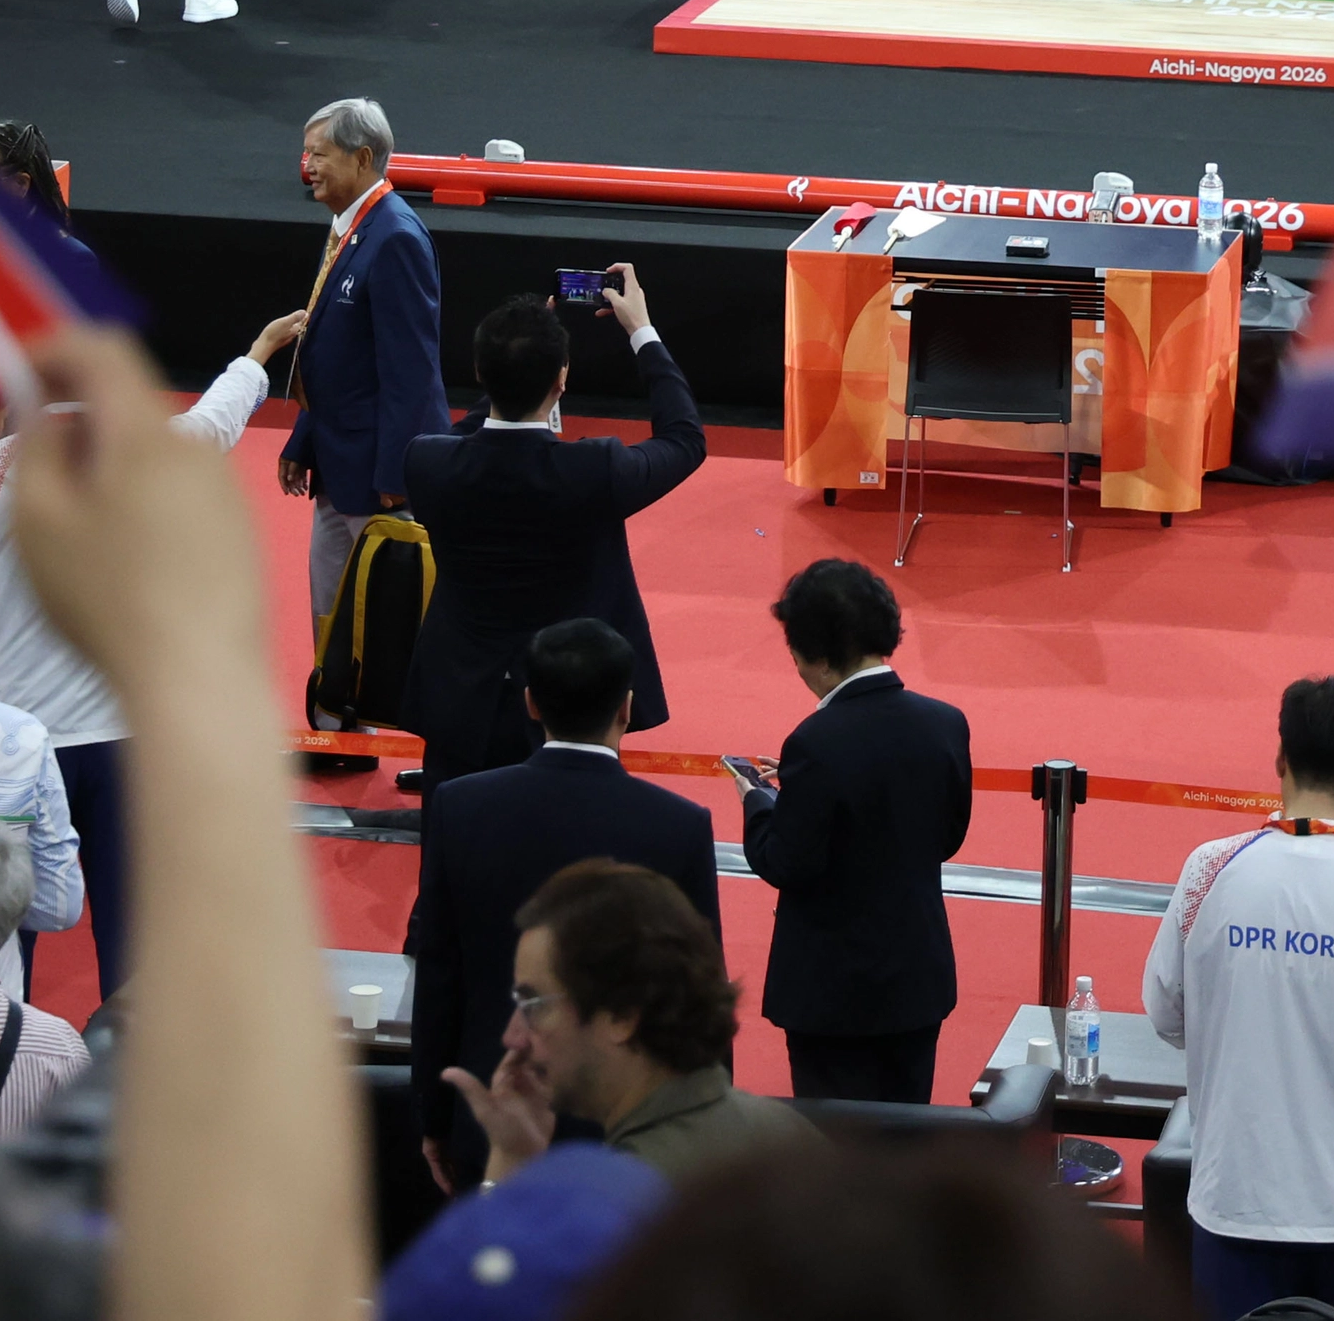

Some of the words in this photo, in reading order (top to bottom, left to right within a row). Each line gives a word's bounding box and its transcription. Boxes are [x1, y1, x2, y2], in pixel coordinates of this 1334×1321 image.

[1149, 57, 1276, 83] Aichi-Nagoya
[1280, 65, 1327, 83] 2026
[304, 736, 331, 747] 2026
[1182, 790, 1257, 809] Aichi-Nagoya
[1228, 924, 1277, 952] DPR
